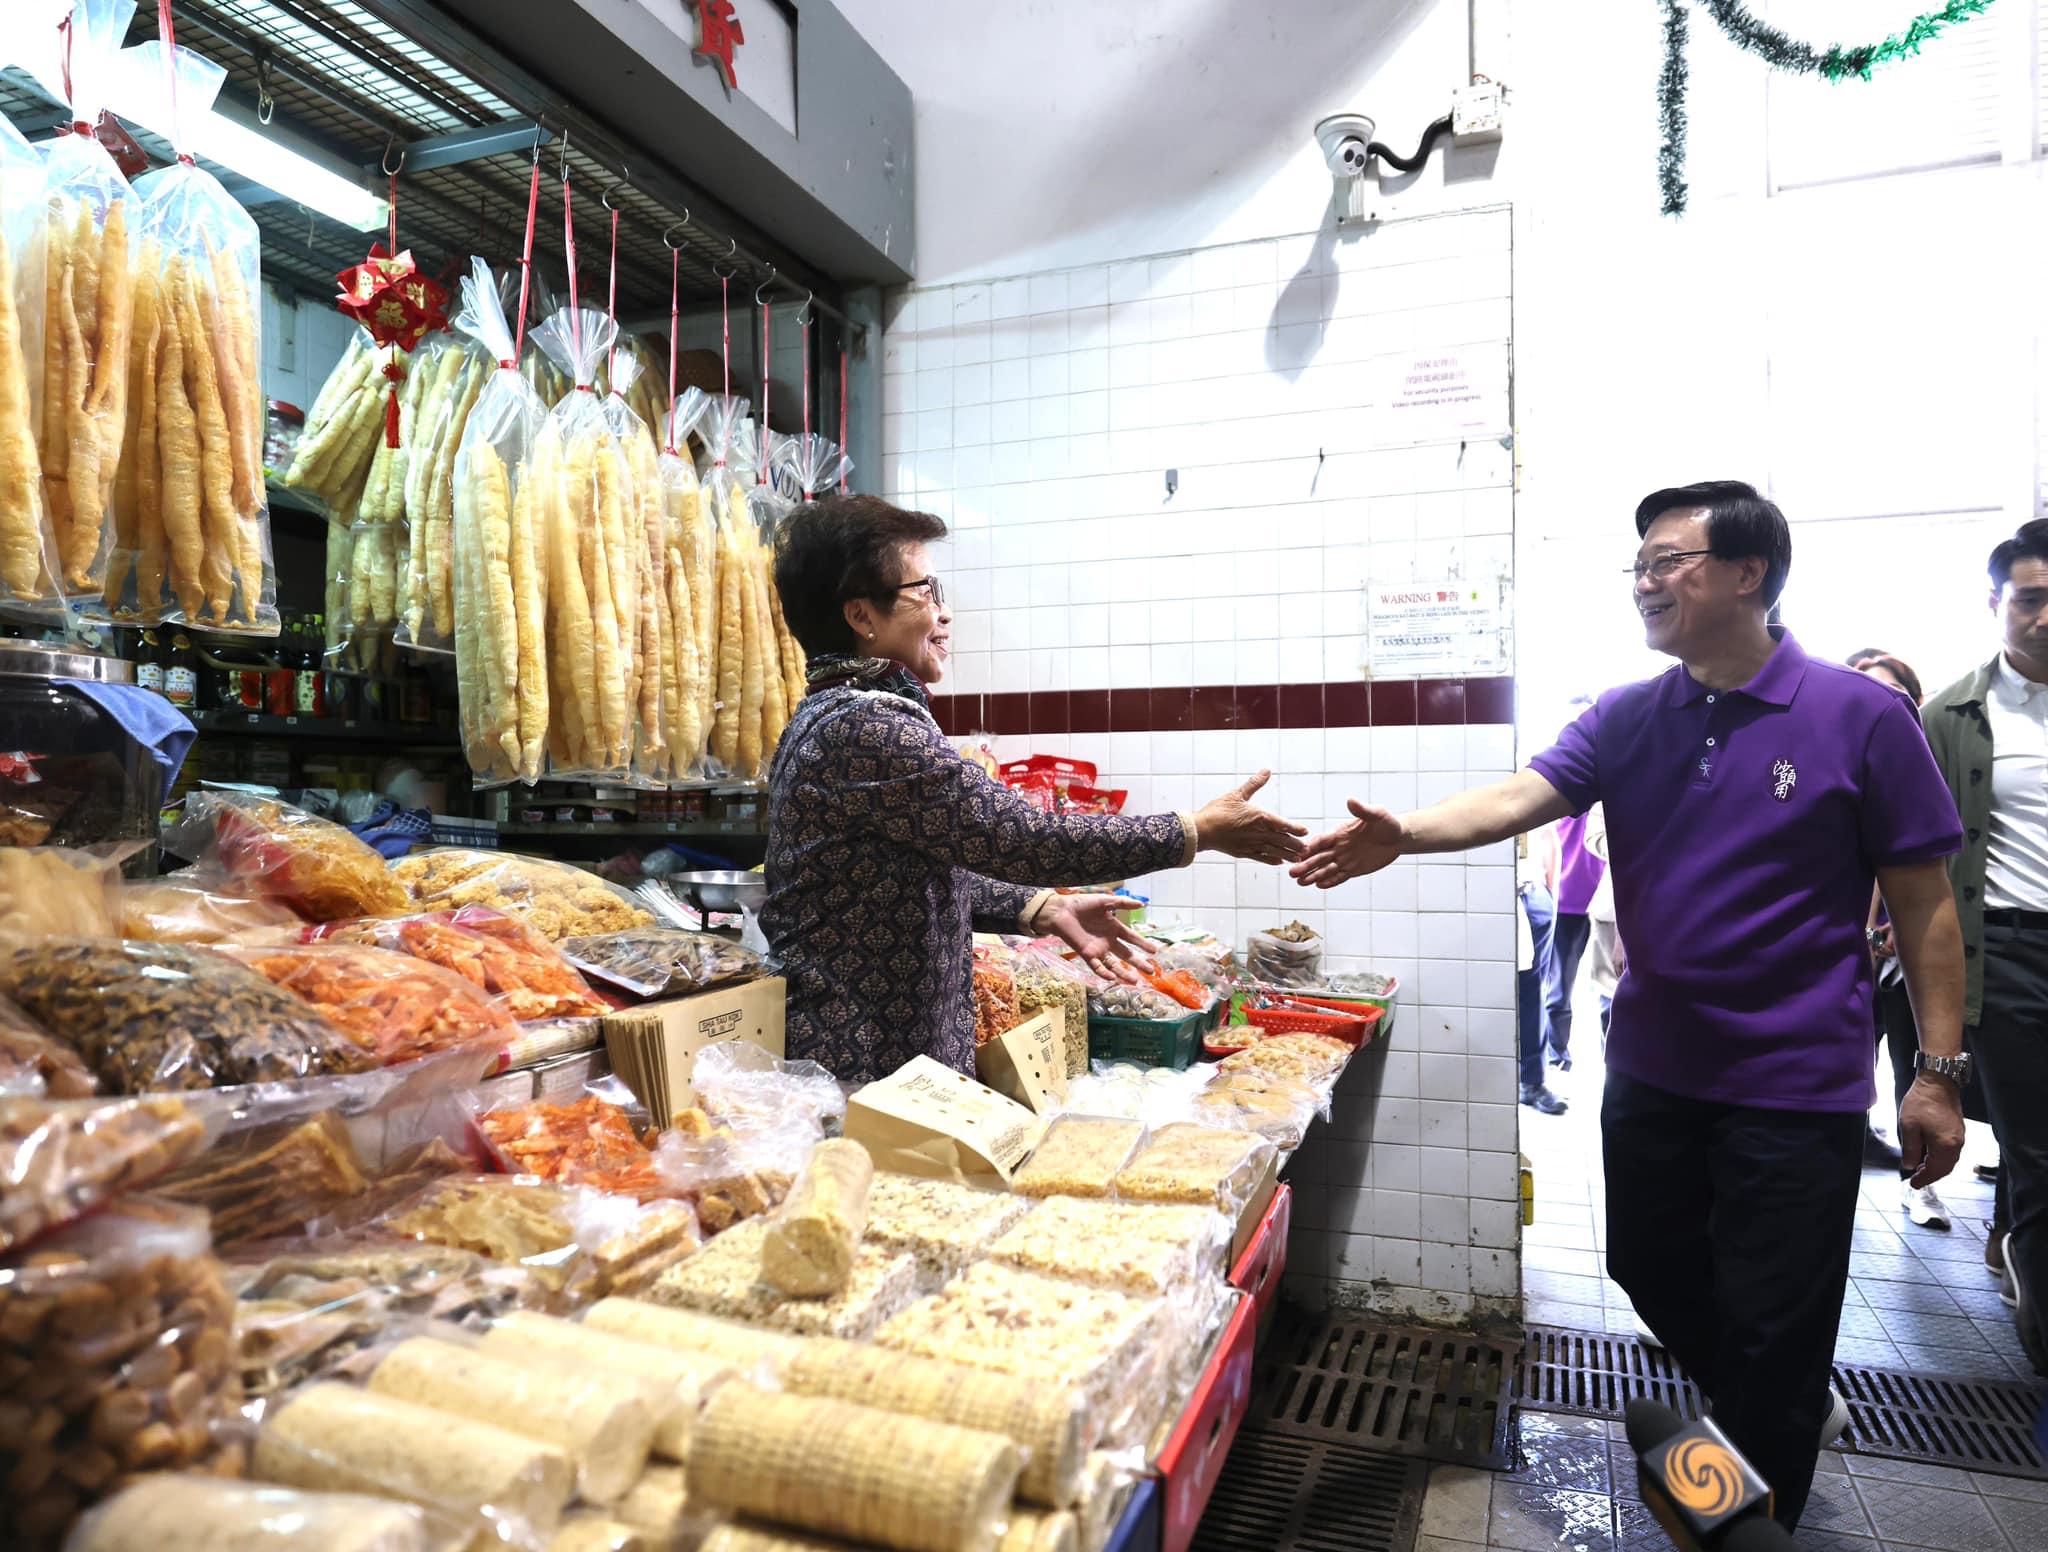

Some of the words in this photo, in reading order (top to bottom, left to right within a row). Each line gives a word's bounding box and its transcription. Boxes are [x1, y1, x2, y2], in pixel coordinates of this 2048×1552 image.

[1415, 387, 1439, 396] security
[1410, 398, 1439, 406] recording
[1454, 394, 1482, 403] progress
[1381, 592, 1431, 605] WARNING
[1437, 591, 1459, 603] 警告
[702, 1020, 715, 1029] SHA
[716, 1016, 727, 1025] TAU
